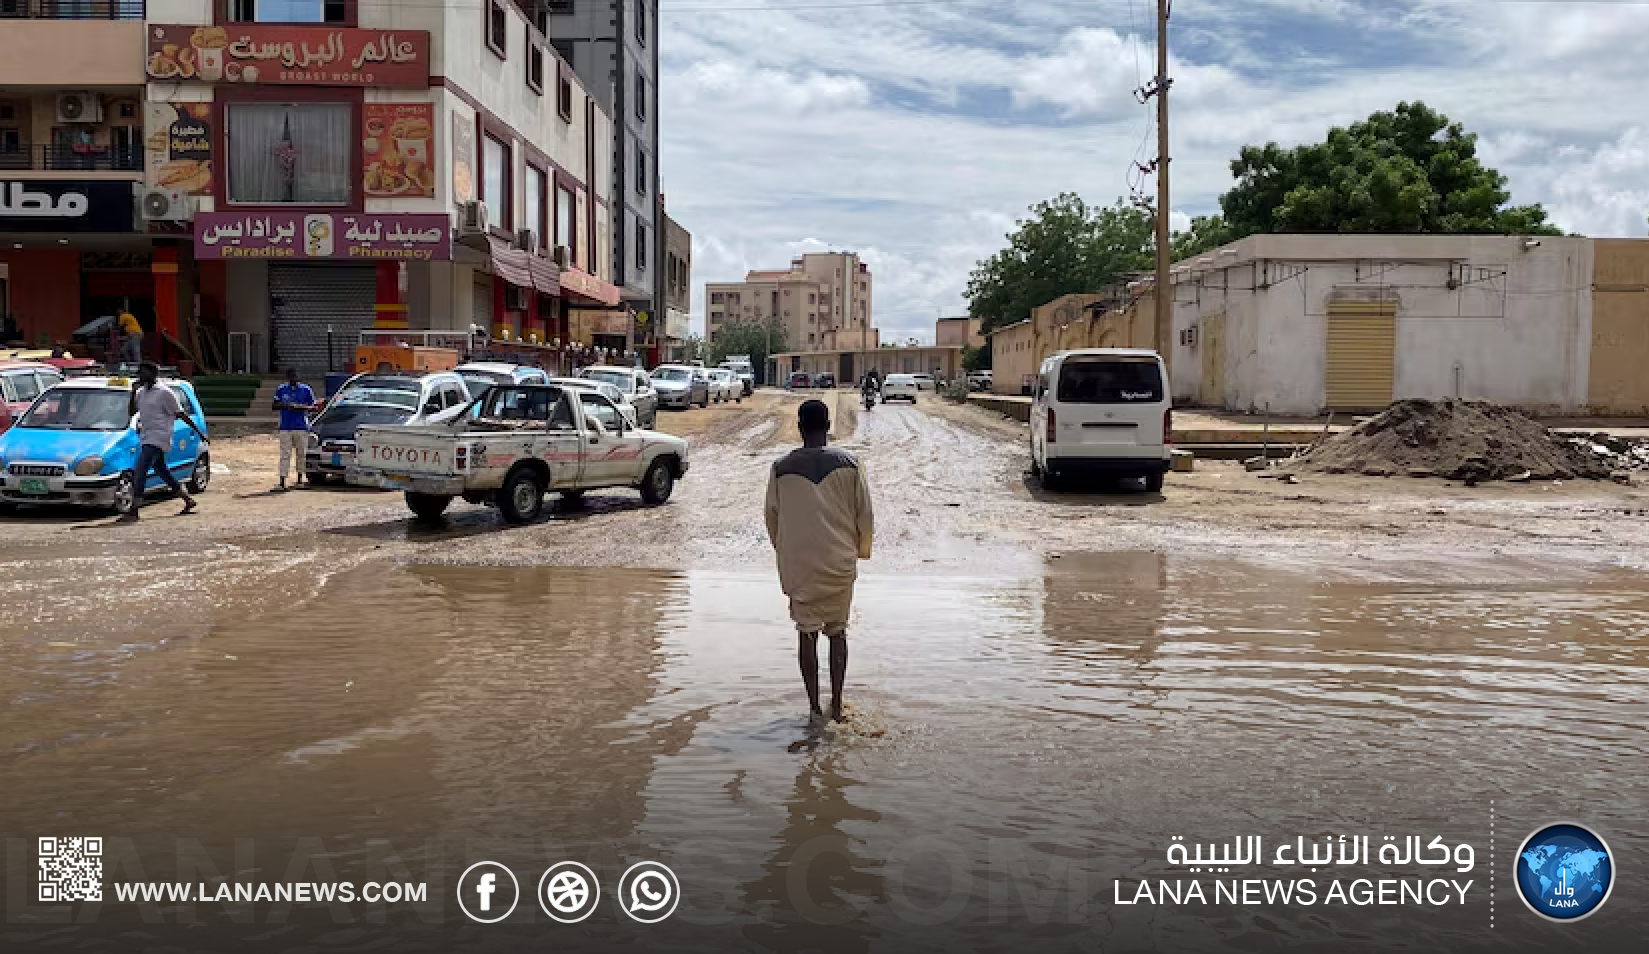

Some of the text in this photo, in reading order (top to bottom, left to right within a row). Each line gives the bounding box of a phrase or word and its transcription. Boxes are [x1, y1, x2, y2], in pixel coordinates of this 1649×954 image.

[229, 31, 417, 69] عالم البروست
[332, 73, 374, 83] WORLD
[202, 216, 443, 247] صيدلية برادايس
[221, 245, 433, 259] Paradise Pharmacy
[371, 445, 441, 466] TOYOTA
